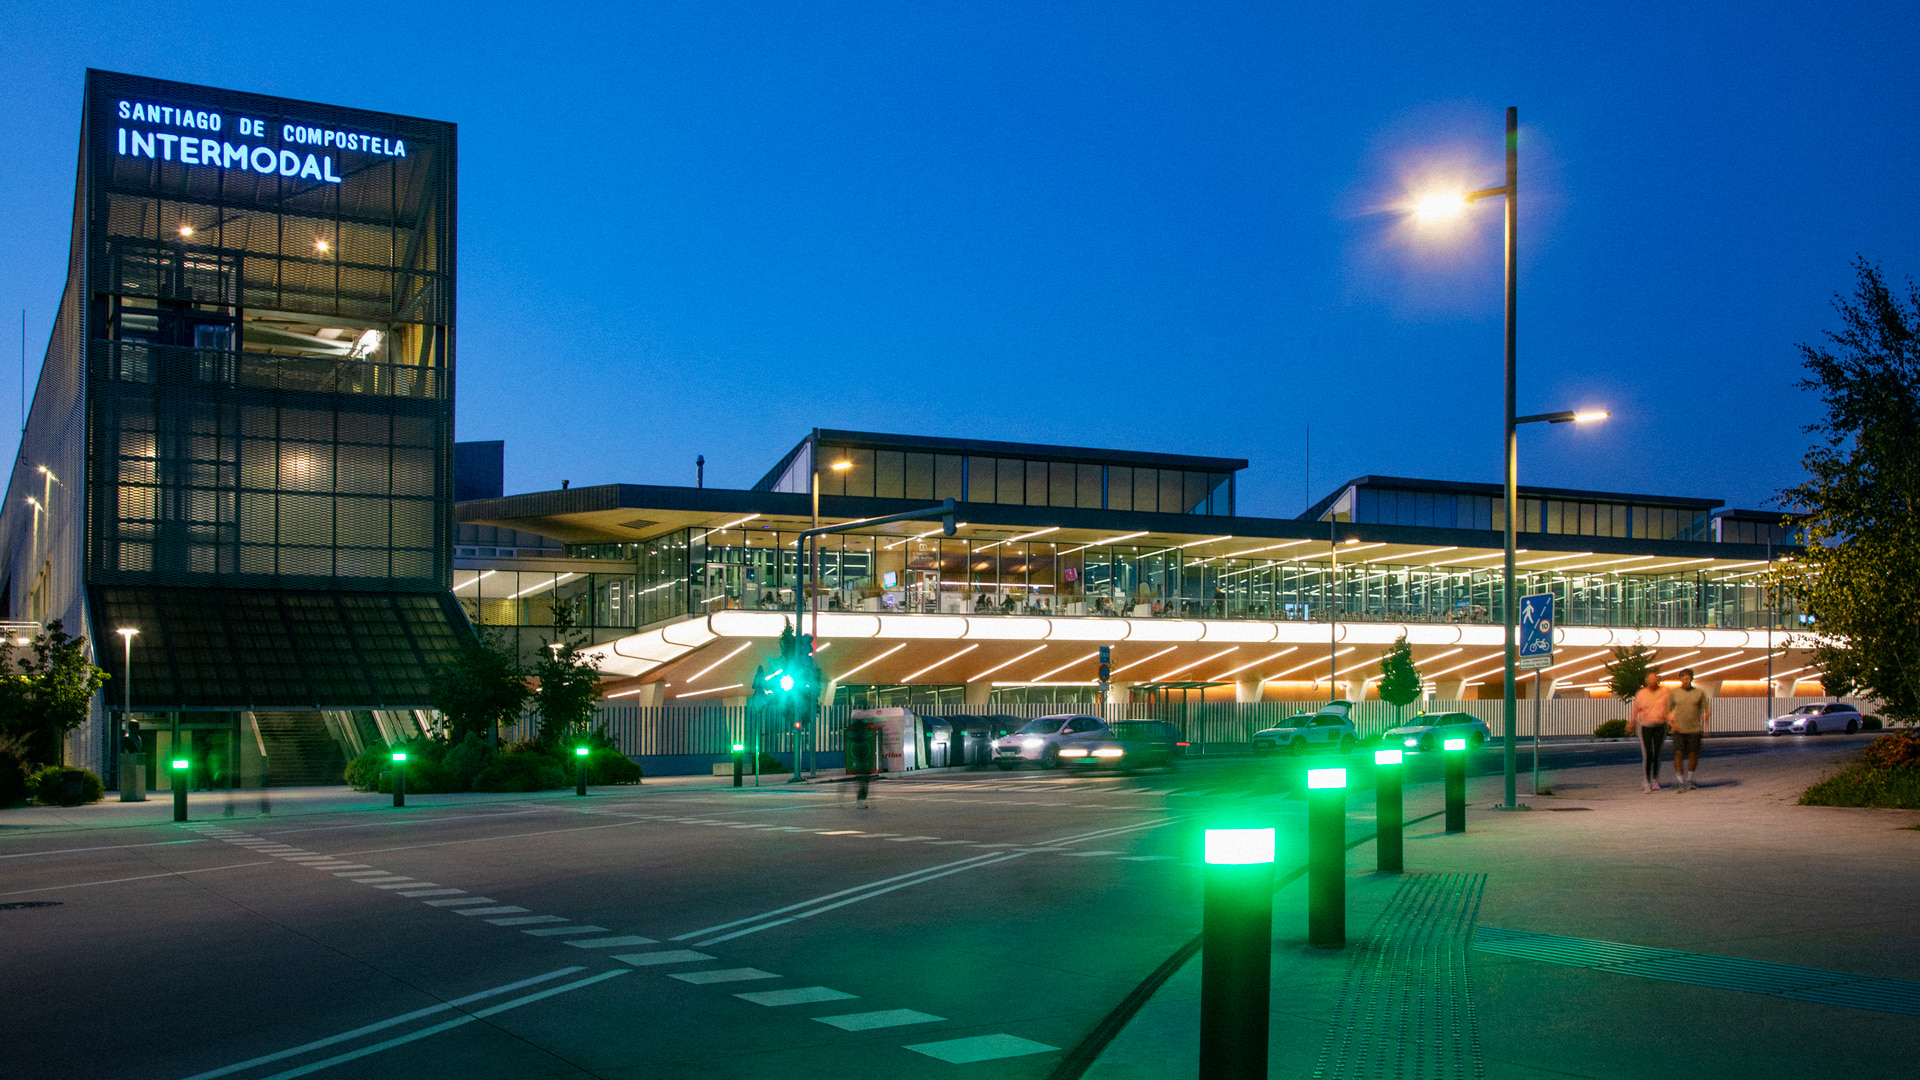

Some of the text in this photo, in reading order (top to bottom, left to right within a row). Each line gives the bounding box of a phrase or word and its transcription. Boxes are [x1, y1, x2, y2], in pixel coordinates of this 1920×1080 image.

[118, 100, 406, 158] SANTIAGO DE COMPOSTELA
[118, 127, 342, 184] INTERMODAL
